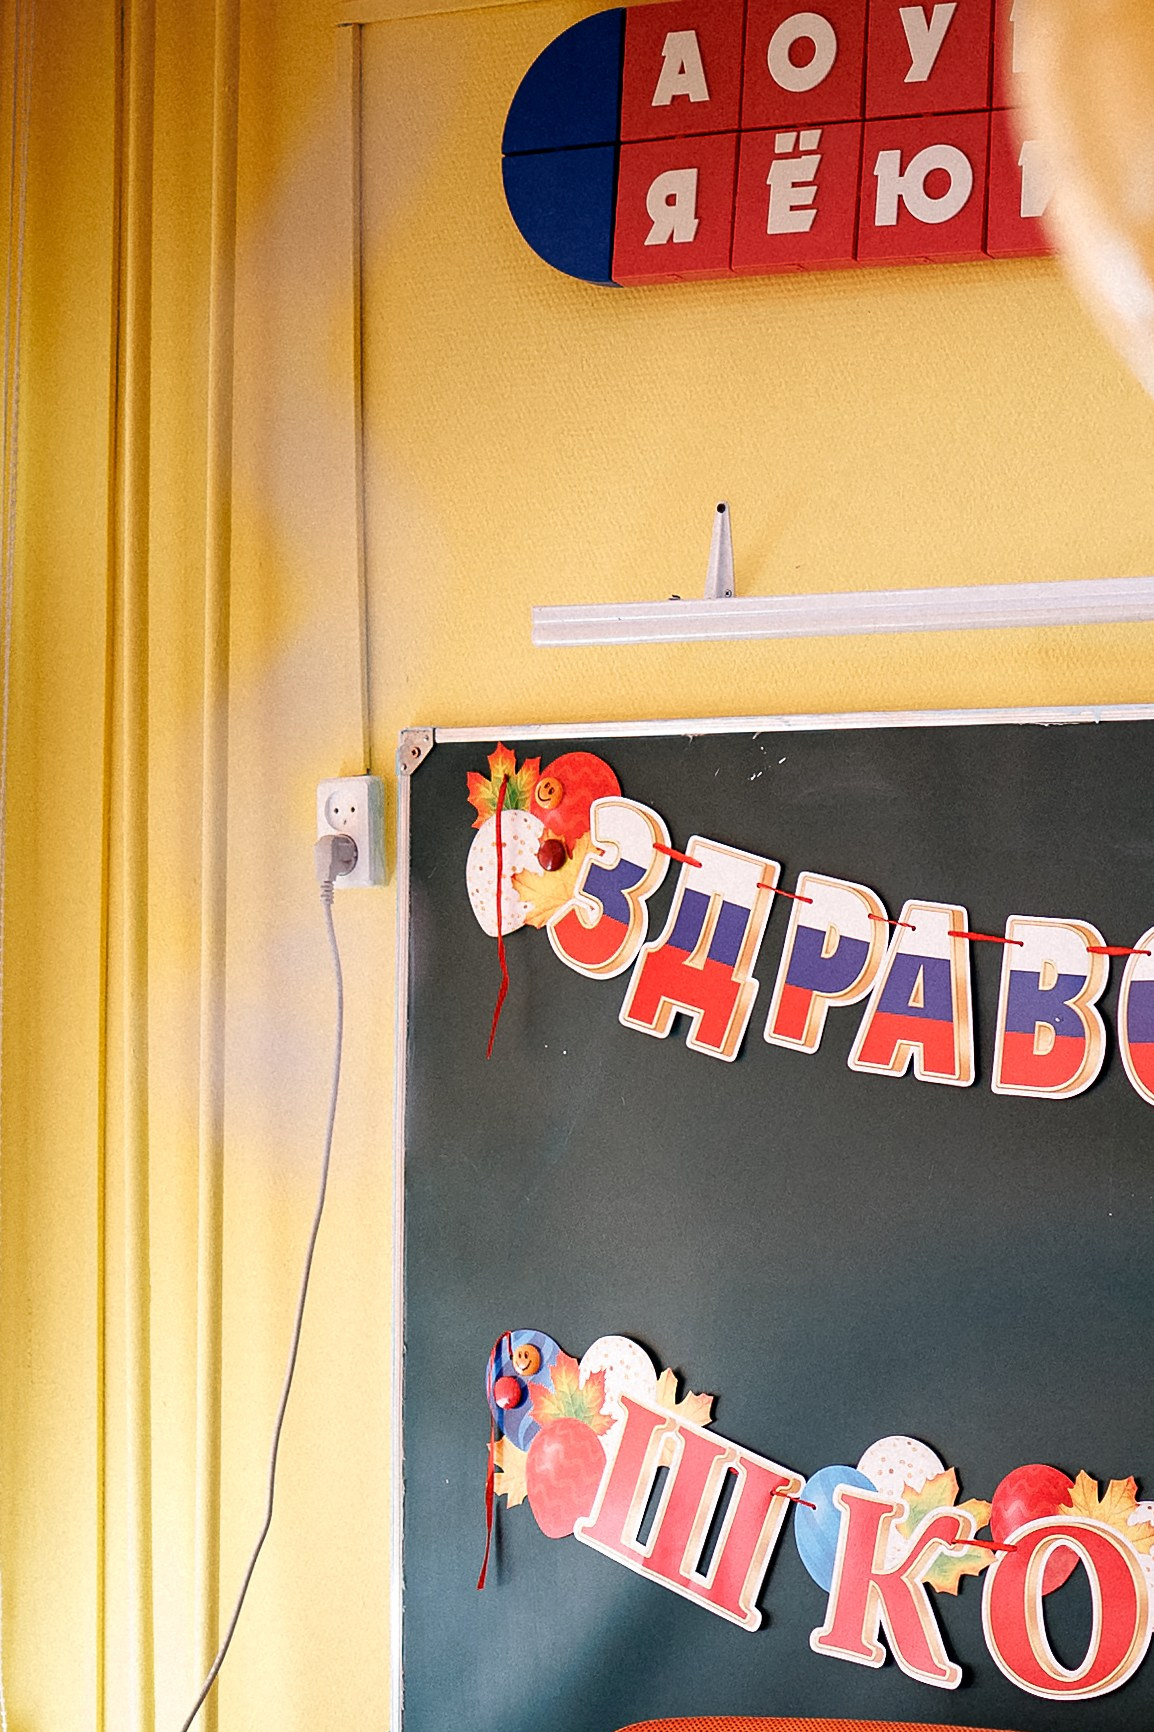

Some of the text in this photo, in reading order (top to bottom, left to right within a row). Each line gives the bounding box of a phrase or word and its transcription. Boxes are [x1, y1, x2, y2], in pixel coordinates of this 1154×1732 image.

[651, 29, 709, 106] А
[767, 12, 838, 92] О
[899, 2, 957, 83] У
[643, 168, 699, 245] Я
[766, 129, 822, 234] Ё
[873, 143, 973, 226] Ю
